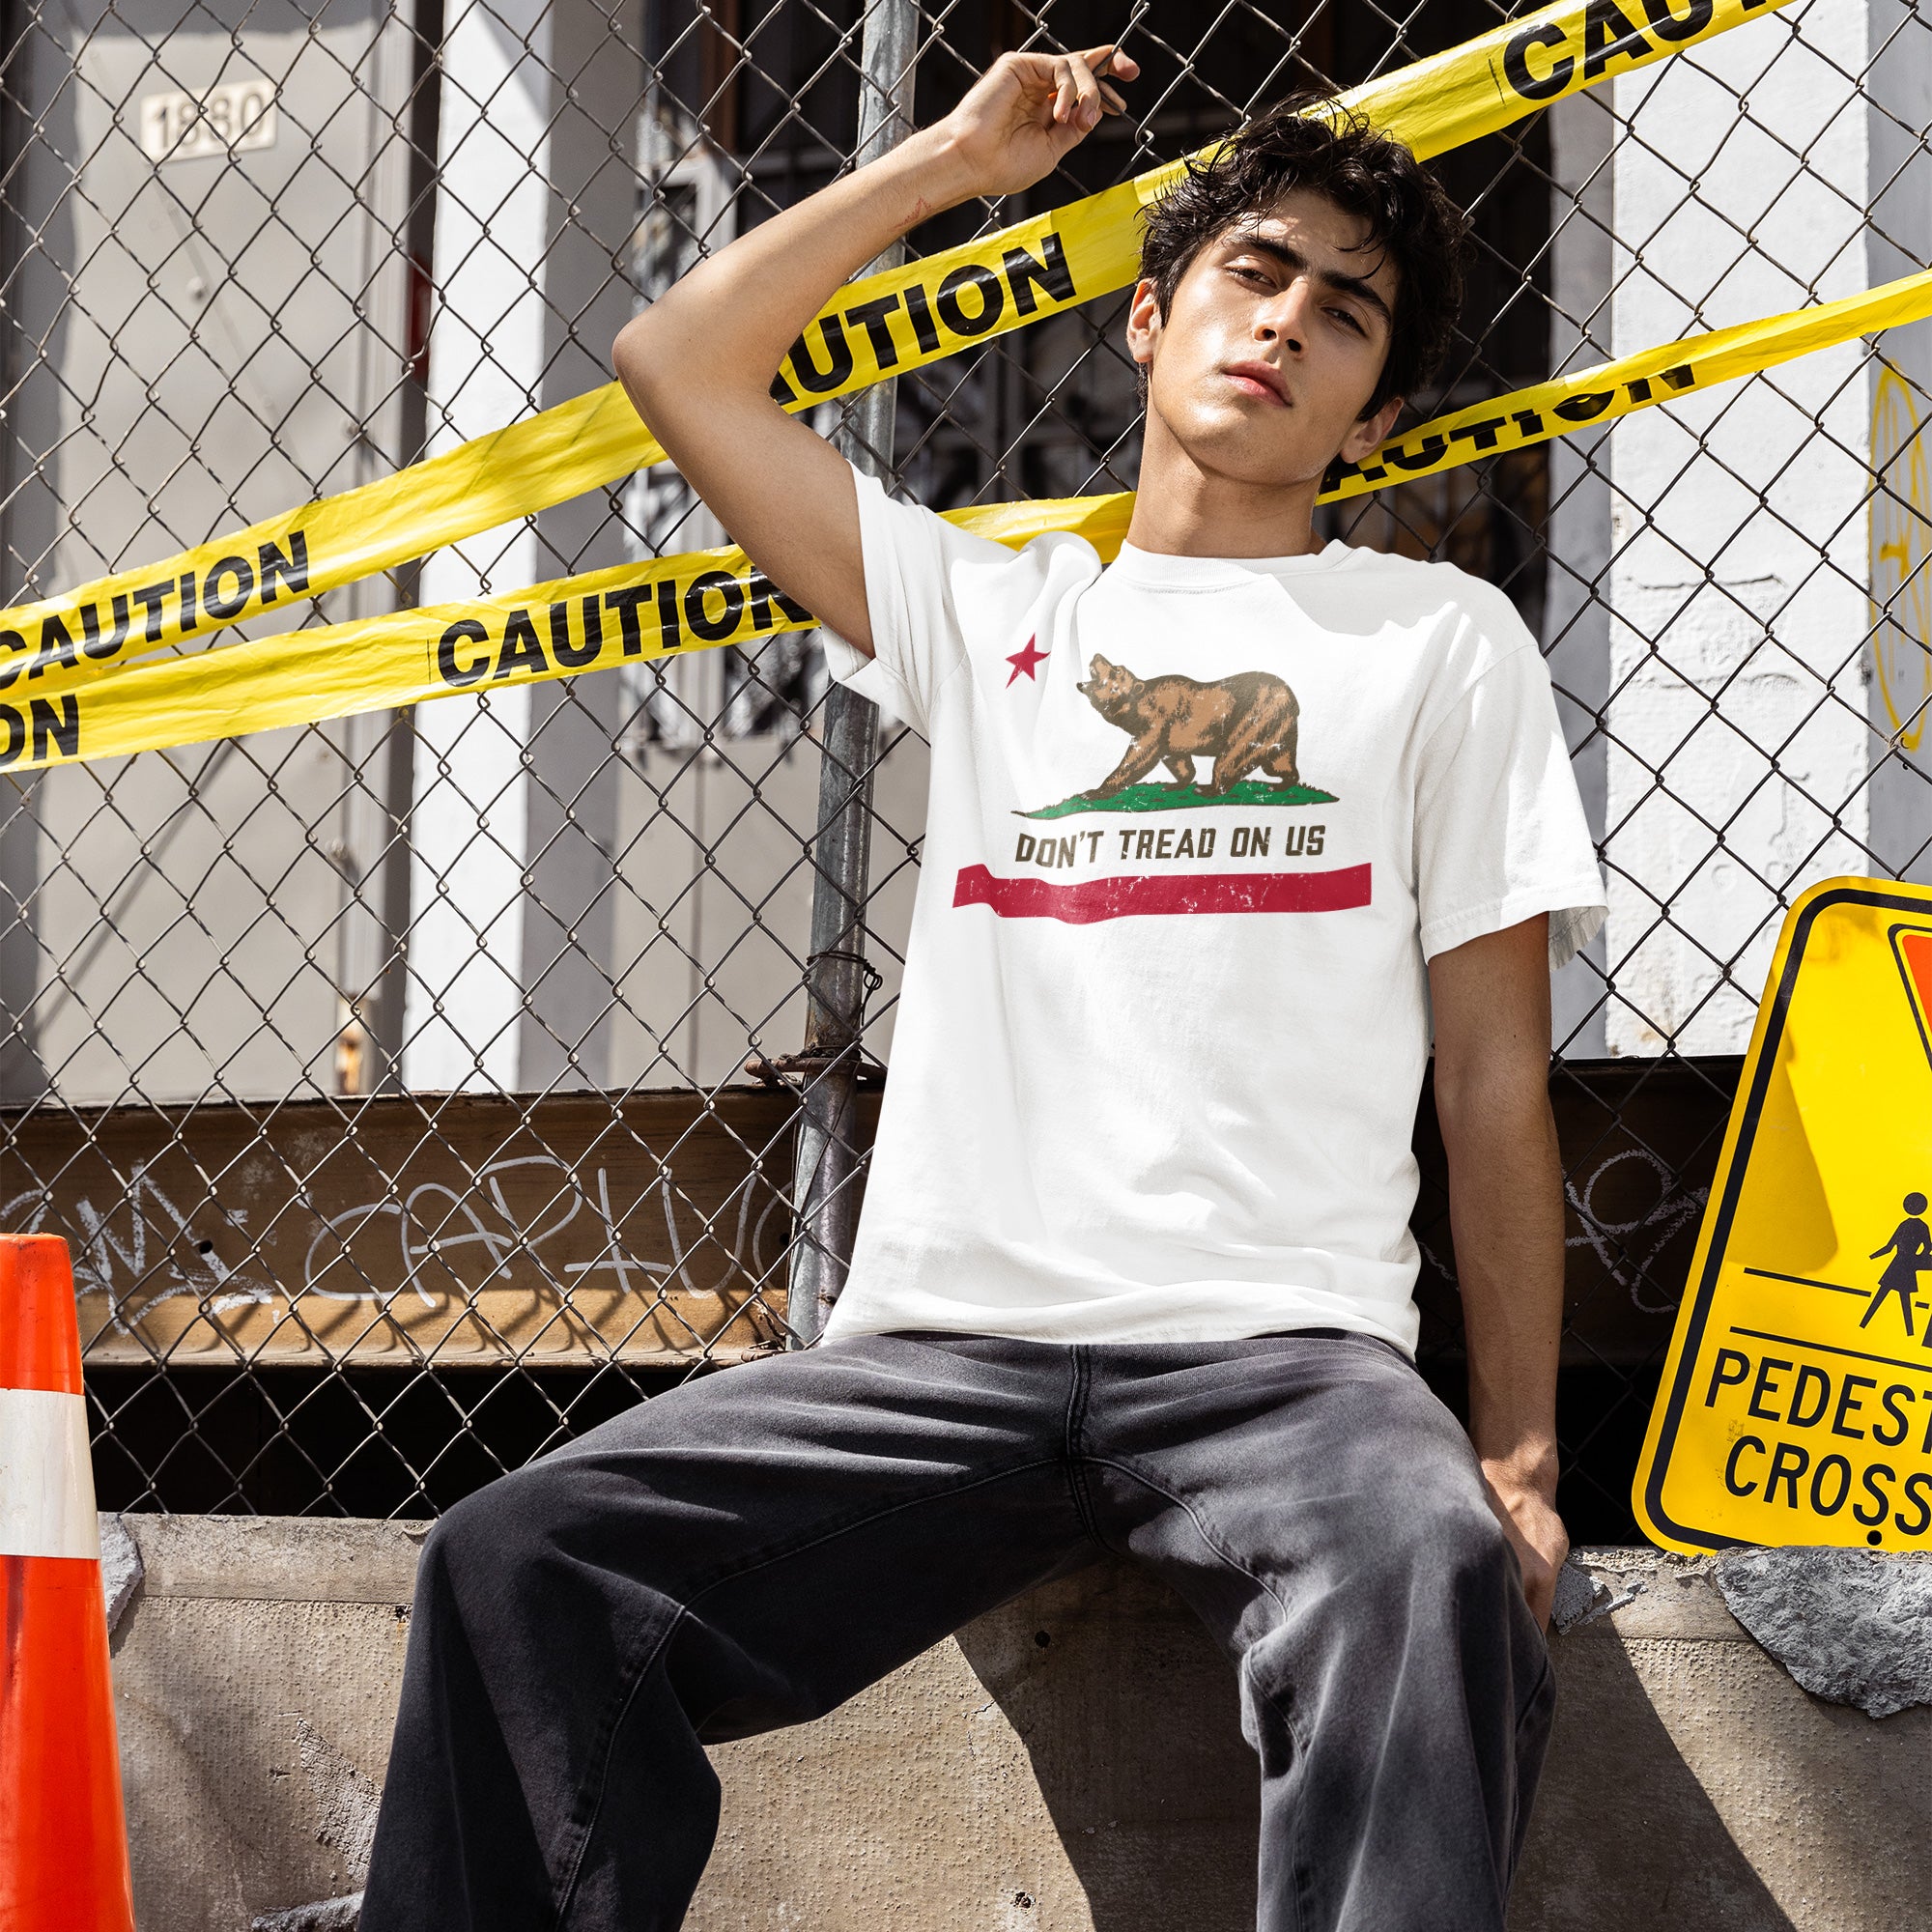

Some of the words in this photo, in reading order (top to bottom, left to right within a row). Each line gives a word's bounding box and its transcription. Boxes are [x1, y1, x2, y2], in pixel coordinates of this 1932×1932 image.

[1503, 0, 1767, 100] CAU
[154, 93, 264, 148] 1880
[0, 529, 310, 690] CAUTION
[1014, 830, 1104, 868] DON'T
[1118, 828, 1215, 861] TREAD
[1230, 827, 1270, 858] ON
[1286, 825, 1326, 857] US
[1724, 1435, 1932, 1536] CROSS
